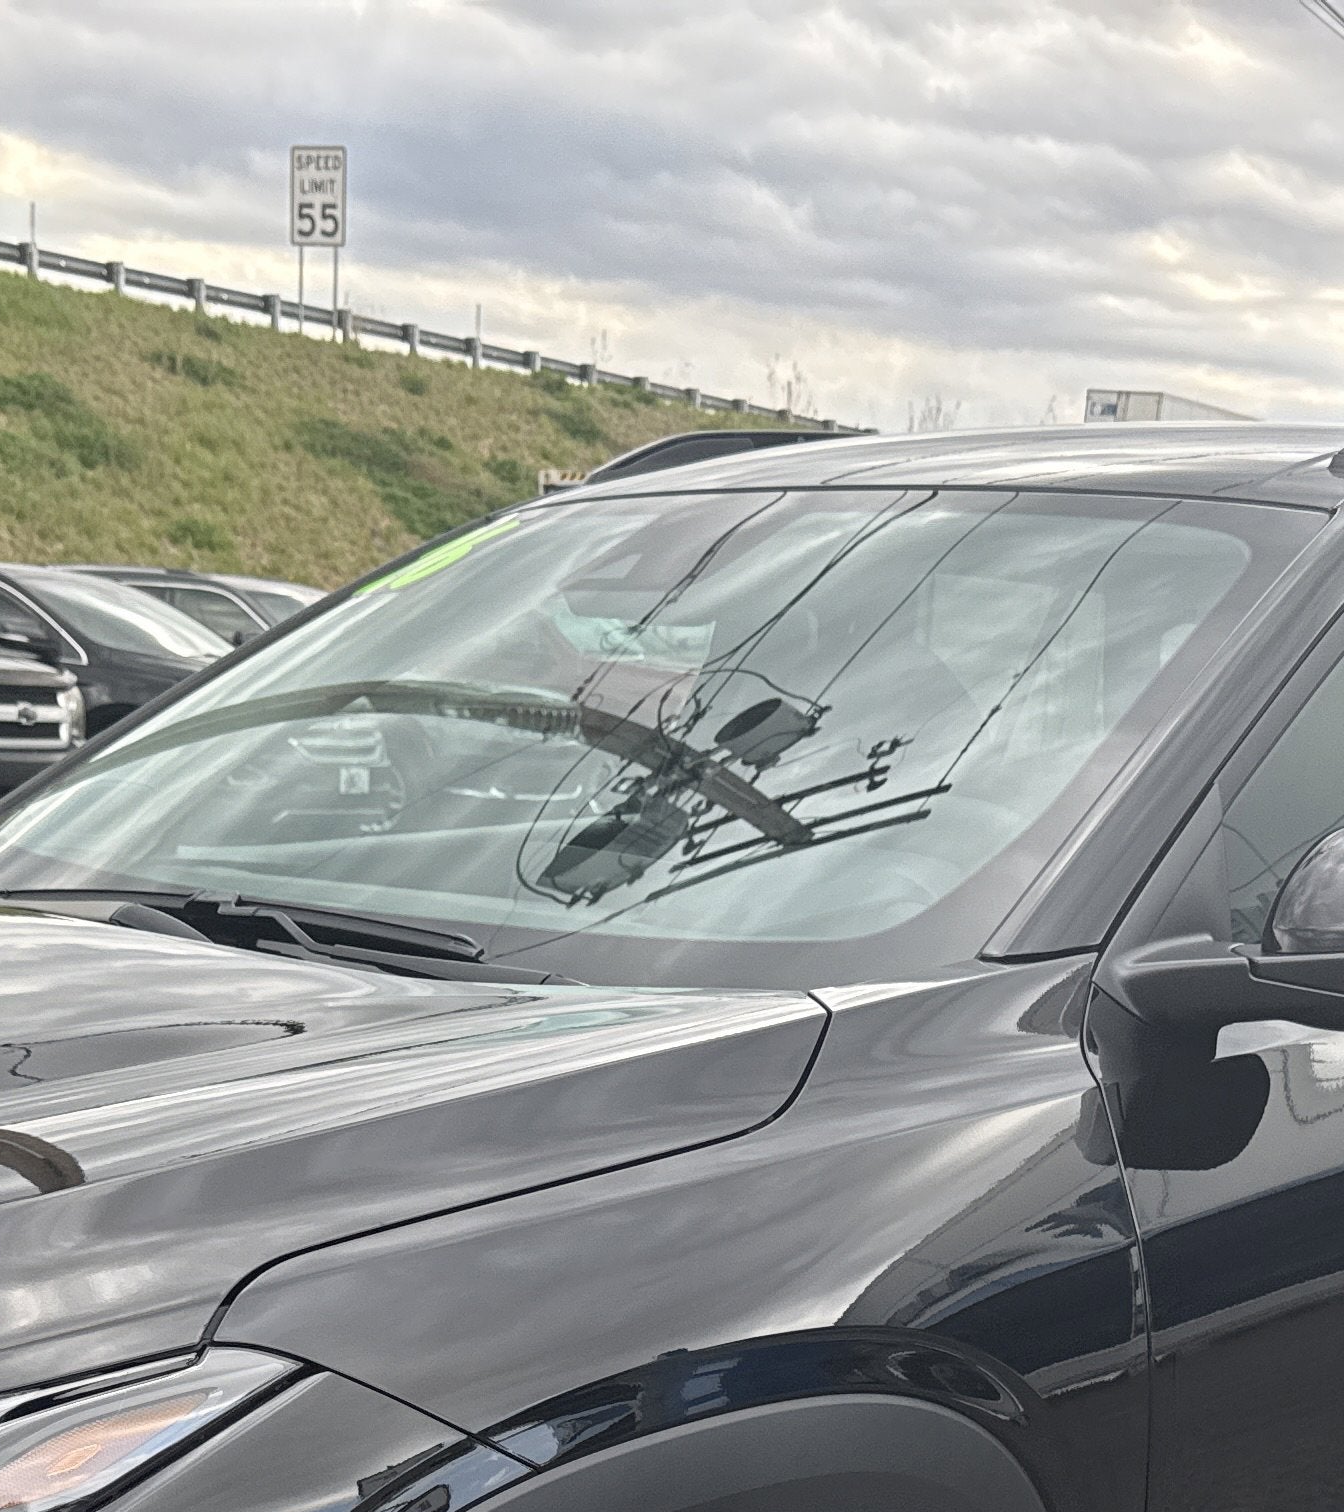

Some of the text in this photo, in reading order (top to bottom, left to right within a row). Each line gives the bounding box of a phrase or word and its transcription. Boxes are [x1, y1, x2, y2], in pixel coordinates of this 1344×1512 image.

[296, 153, 342, 171] SPEED
[299, 178, 337, 195] LIMIT
[297, 202, 339, 237] 55
